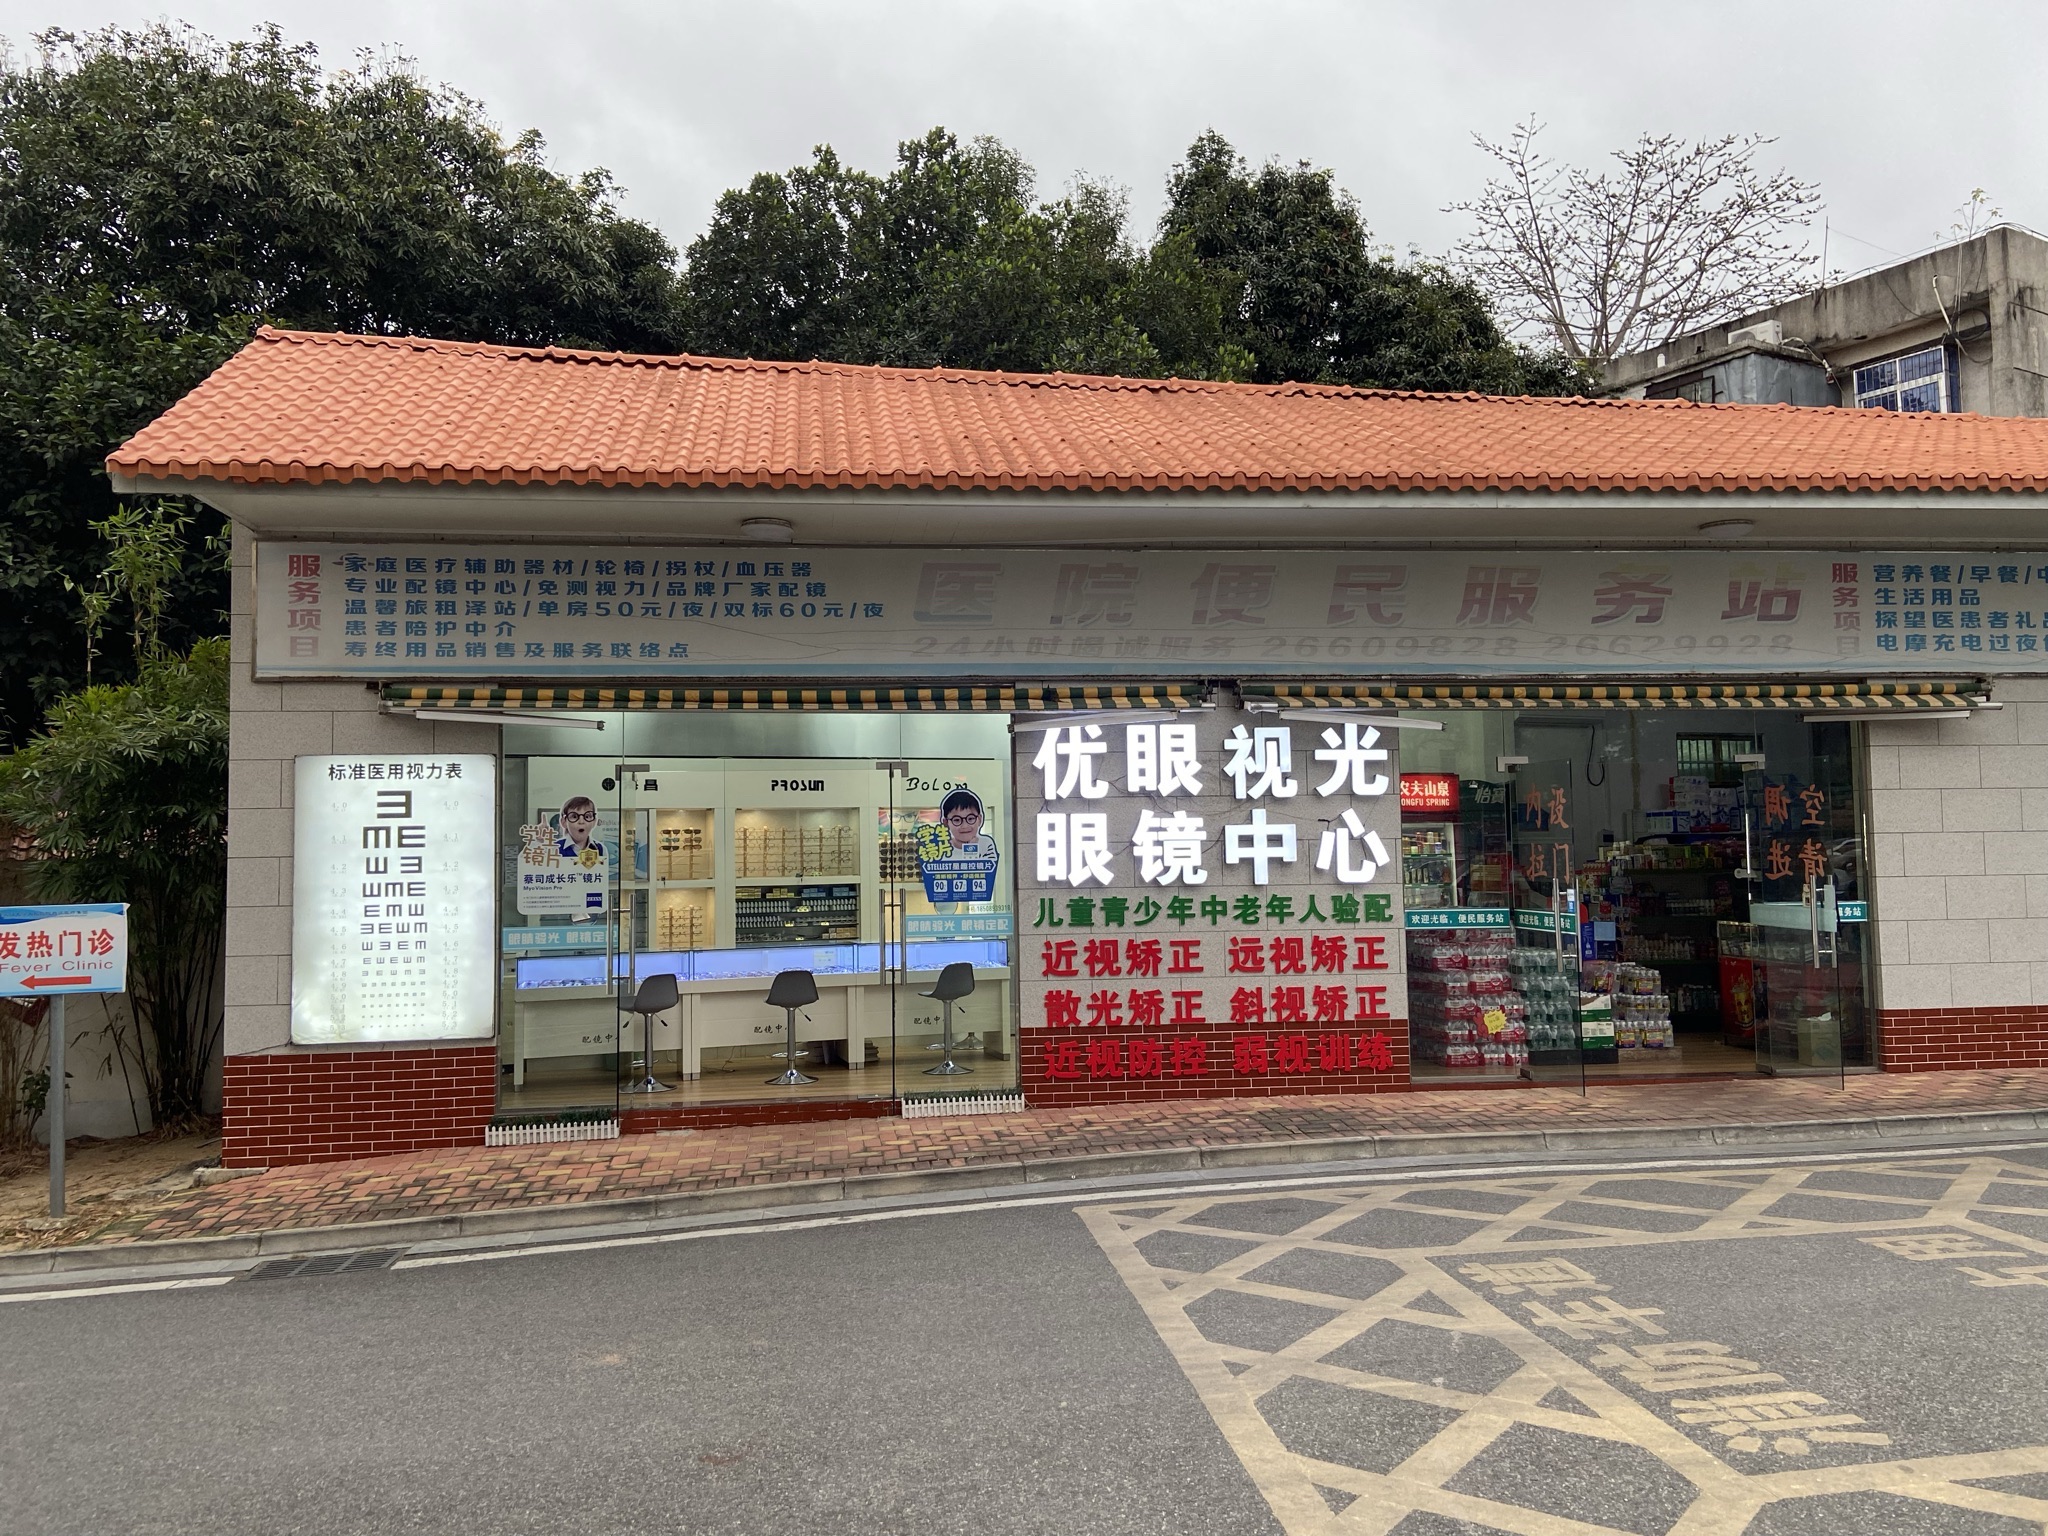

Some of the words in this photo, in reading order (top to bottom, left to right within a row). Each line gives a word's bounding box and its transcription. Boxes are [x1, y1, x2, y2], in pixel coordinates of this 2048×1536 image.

[344, 556, 812, 577] 家庭医疗辅助器材/轮椅/拐杖/血压器
[344, 577, 827, 598] 专业配镜中心/免测视力/品牌厂家配镜
[912, 561, 1807, 626] 医院便民服务站
[1874, 588, 1980, 606] 生活用品
[287, 554, 322, 658] 服务项目
[1832, 563, 1861, 655] 服务项目
[344, 620, 516, 638] 患者陪护中介
[344, 641, 689, 659] 寿终用品销售及服务联络点
[328, 762, 463, 781] 标准医用视力表
[1033, 722, 1390, 800] 优眼视光
[1400, 798, 1424, 806] ONGFU
[1426, 798, 1450, 806] SPRING
[520, 825, 560, 847] 学生
[917, 825, 951, 844] 学生
[523, 846, 561, 869] 镜片
[918, 842, 953, 862] 镜片
[1036, 808, 1391, 887] 眼镜中心
[1033, 893, 1394, 928] 儿童青少年中老年人验配
[908, 920, 956, 932] 眼睛验光
[961, 919, 1009, 931] 眼镜定配
[0, 928, 115, 960] 发热门诊
[508, 932, 560, 945] 眼睛验光
[0, 963, 52, 974] Fever
[62, 960, 114, 971] Clinic
[1041, 938, 1205, 978] 近视矫正
[1228, 935, 1390, 974] 远视矫正
[1044, 988, 1207, 1029] 散光矫正
[1230, 984, 1391, 1025] 斜视矫正
[1043, 1036, 1209, 1081] 近视防控
[1233, 1032, 1394, 1076] 弱视训练
[1459, 1257, 1892, 1456] 消防车道
